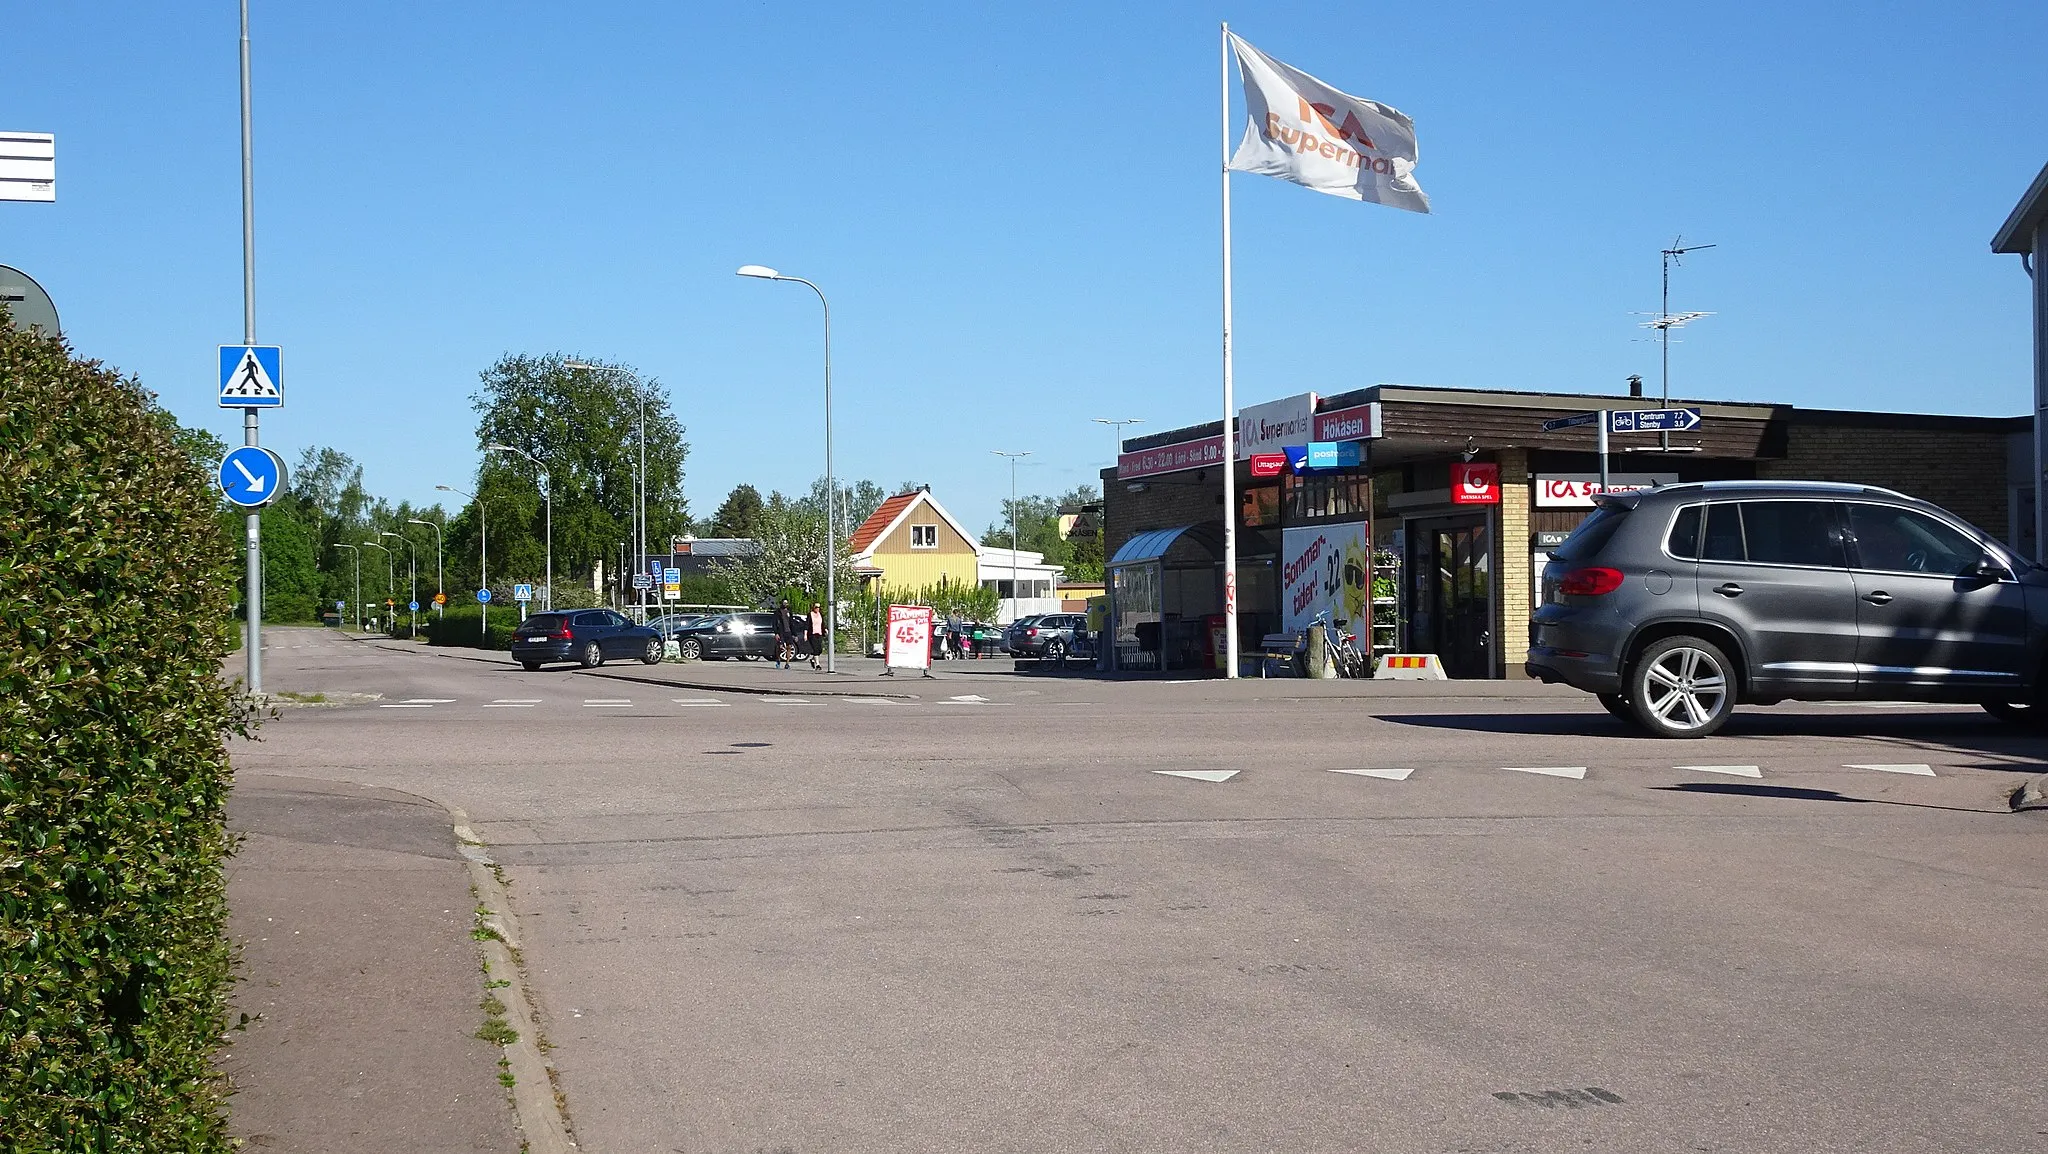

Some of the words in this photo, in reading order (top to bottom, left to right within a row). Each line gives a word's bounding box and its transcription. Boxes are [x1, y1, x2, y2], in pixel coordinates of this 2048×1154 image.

[1297, 97, 1376, 150] ICA
[1639, 412, 1665, 420] Centrum
[1674, 412, 1684, 420] 7,7
[1639, 421, 1661, 429] Stenby
[1242, 419, 1260, 448] ICA
[1261, 411, 1308, 444] Supermarket
[1322, 414, 1364, 440] Hökåsen
[1203, 445, 1217, 461] 9.00
[1545, 480, 1578, 498] ICA
[1068, 516, 1089, 527] ICA
[1293, 570, 1318, 616] tider!
